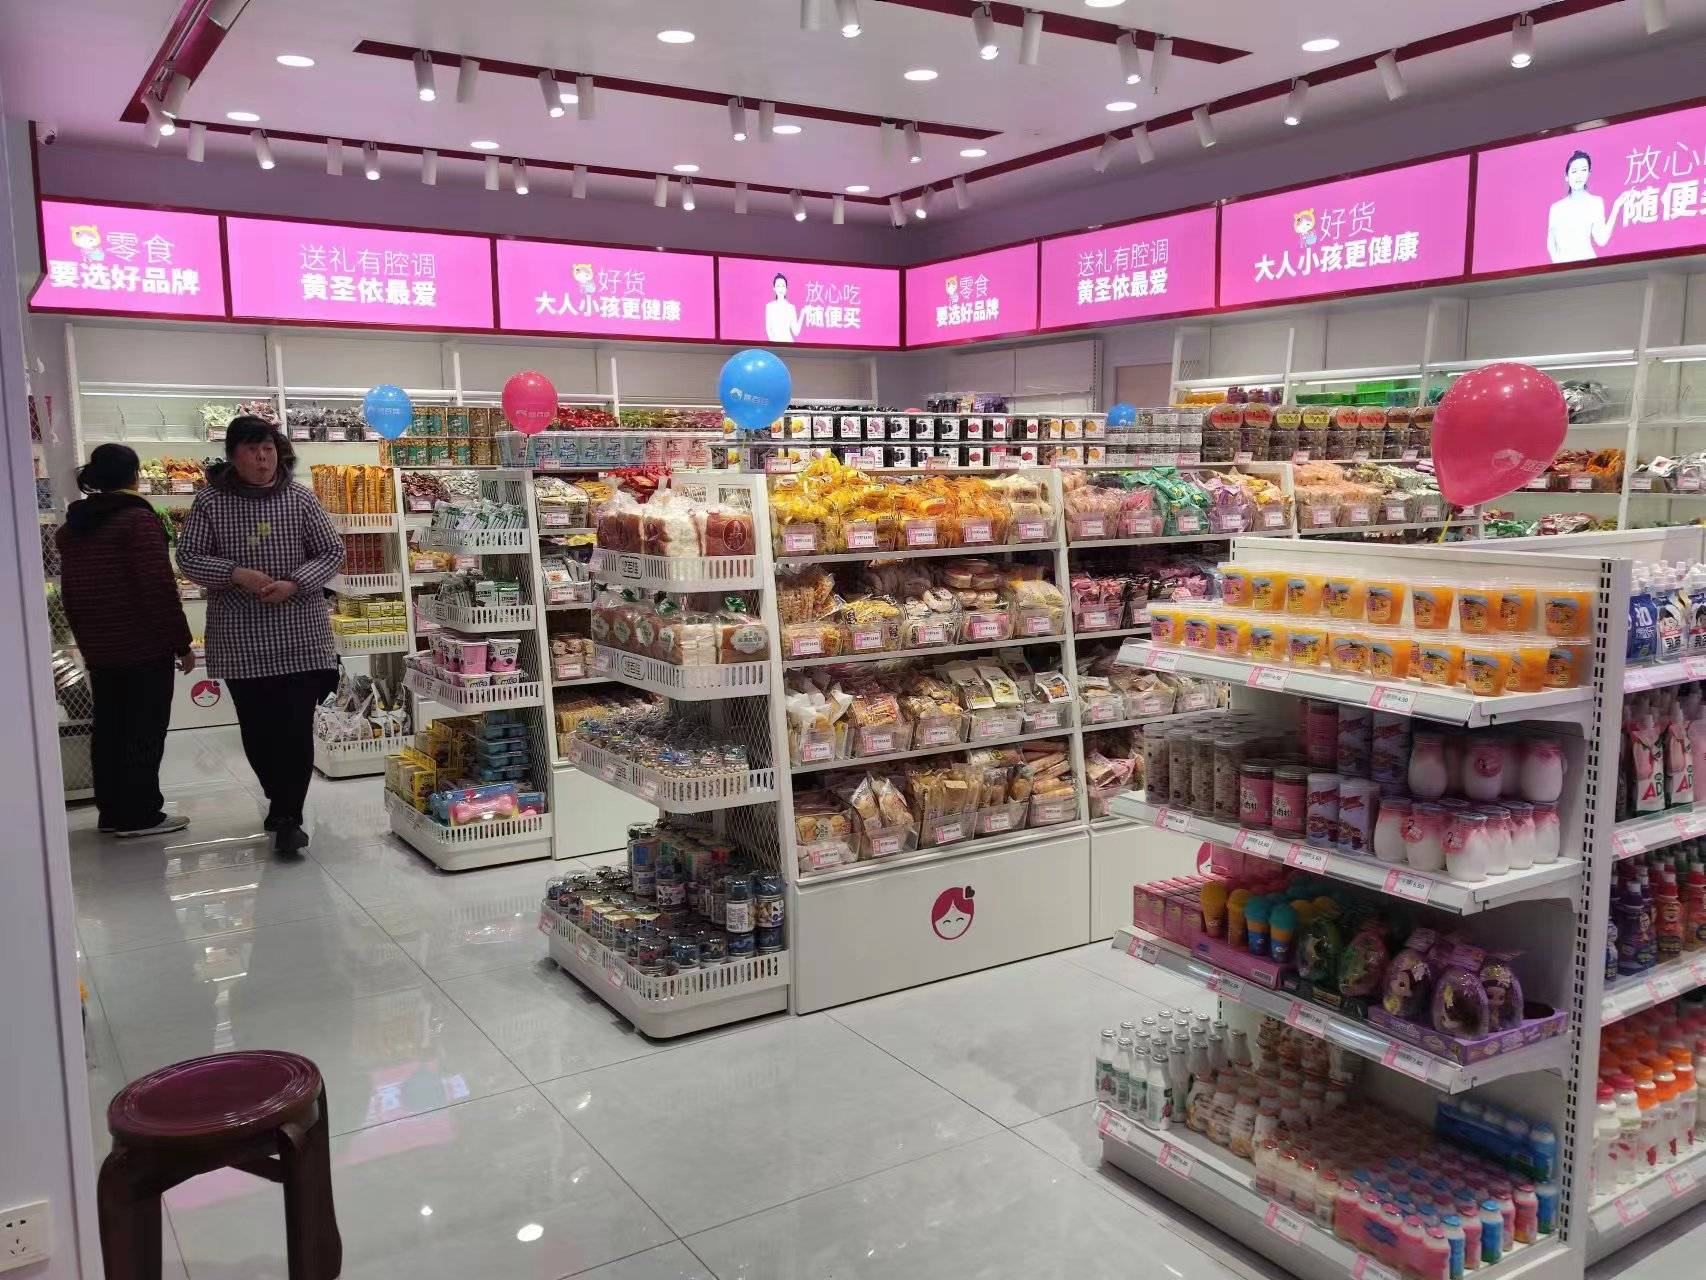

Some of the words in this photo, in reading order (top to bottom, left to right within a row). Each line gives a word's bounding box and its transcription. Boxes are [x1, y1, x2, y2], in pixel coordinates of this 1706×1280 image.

[1624, 145, 1706, 185] 放心
[1319, 201, 1376, 243] 好货
[1622, 180, 1706, 228] 随便
[106, 232, 174, 264] 零食
[300, 244, 437, 280] 送礼有腔调
[1078, 239, 1168, 276] 送礼有腔调
[1254, 231, 1420, 283] 大人小孩更健康
[48, 259, 201, 297] 要选好品牌
[300, 272, 438, 308] 黄圣依最爱
[597, 268, 647, 297] 好货
[804, 280, 862, 306] 放心吃
[958, 273, 991, 300] 零食
[1077, 267, 1169, 306] 黄圣依最爱
[535, 294, 681, 321] 大人小孩更健康
[804, 305, 862, 330] 随便买
[935, 298, 1000, 327] 要选好品牌
